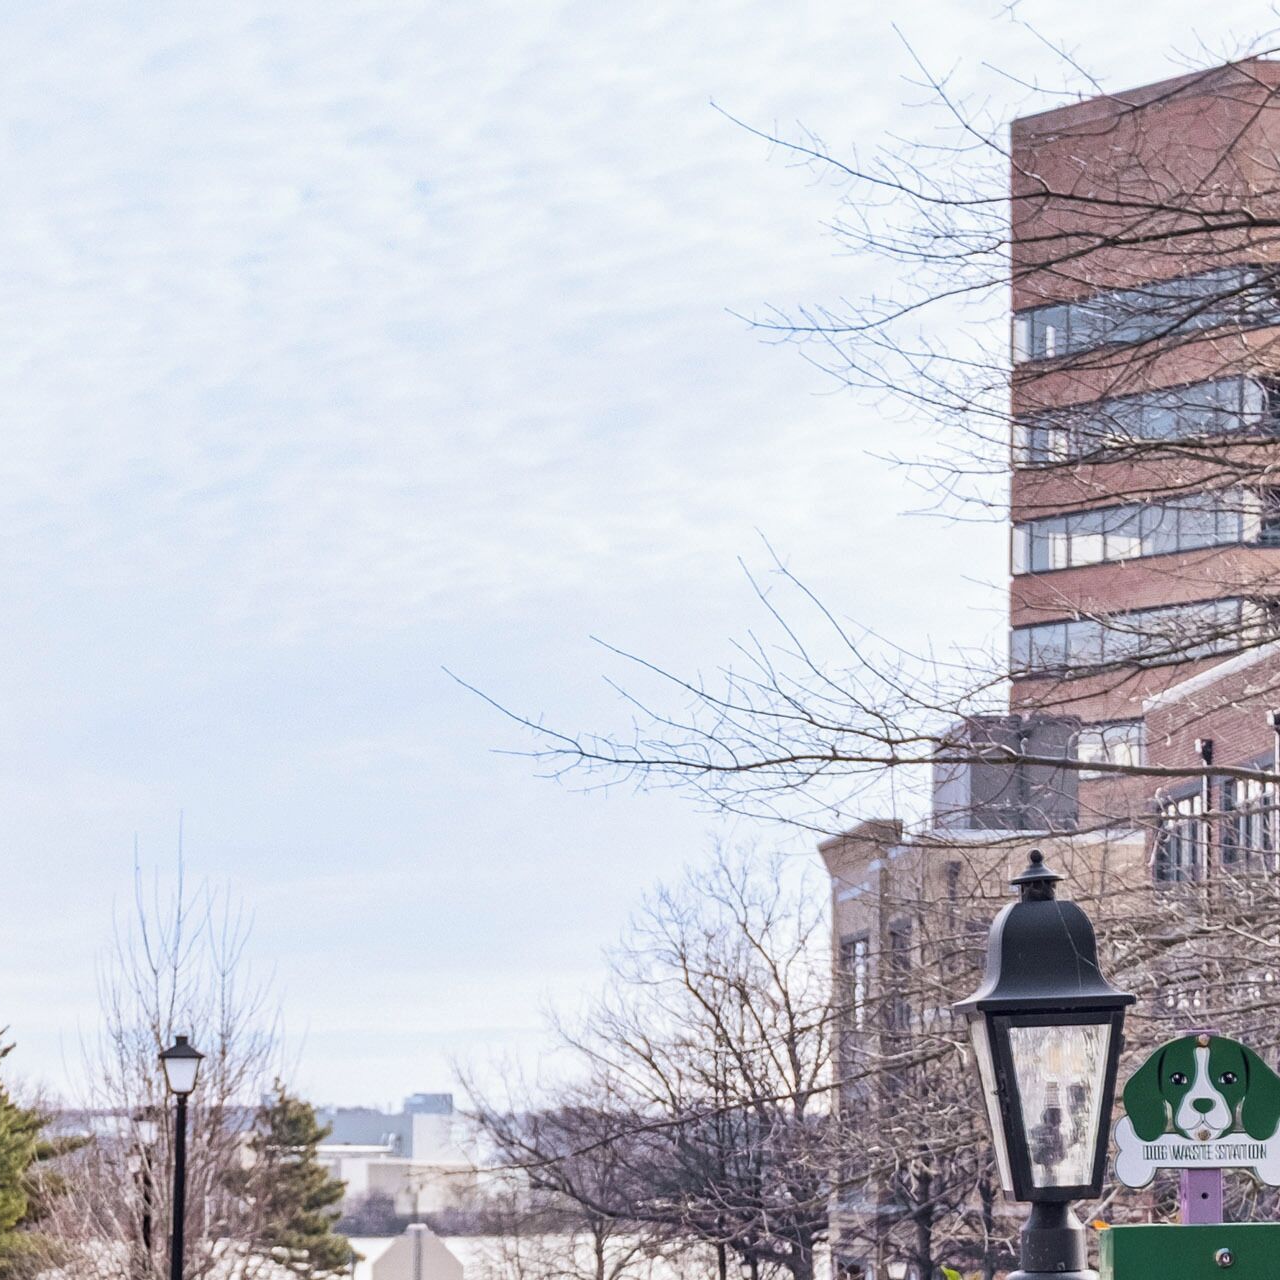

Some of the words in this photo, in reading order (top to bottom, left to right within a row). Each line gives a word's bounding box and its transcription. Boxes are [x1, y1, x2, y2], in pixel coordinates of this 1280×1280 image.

[1142, 1144, 1168, 1160] DOG
[1169, 1144, 1212, 1160] WASTE
[1215, 1143, 1267, 1160] STATION
